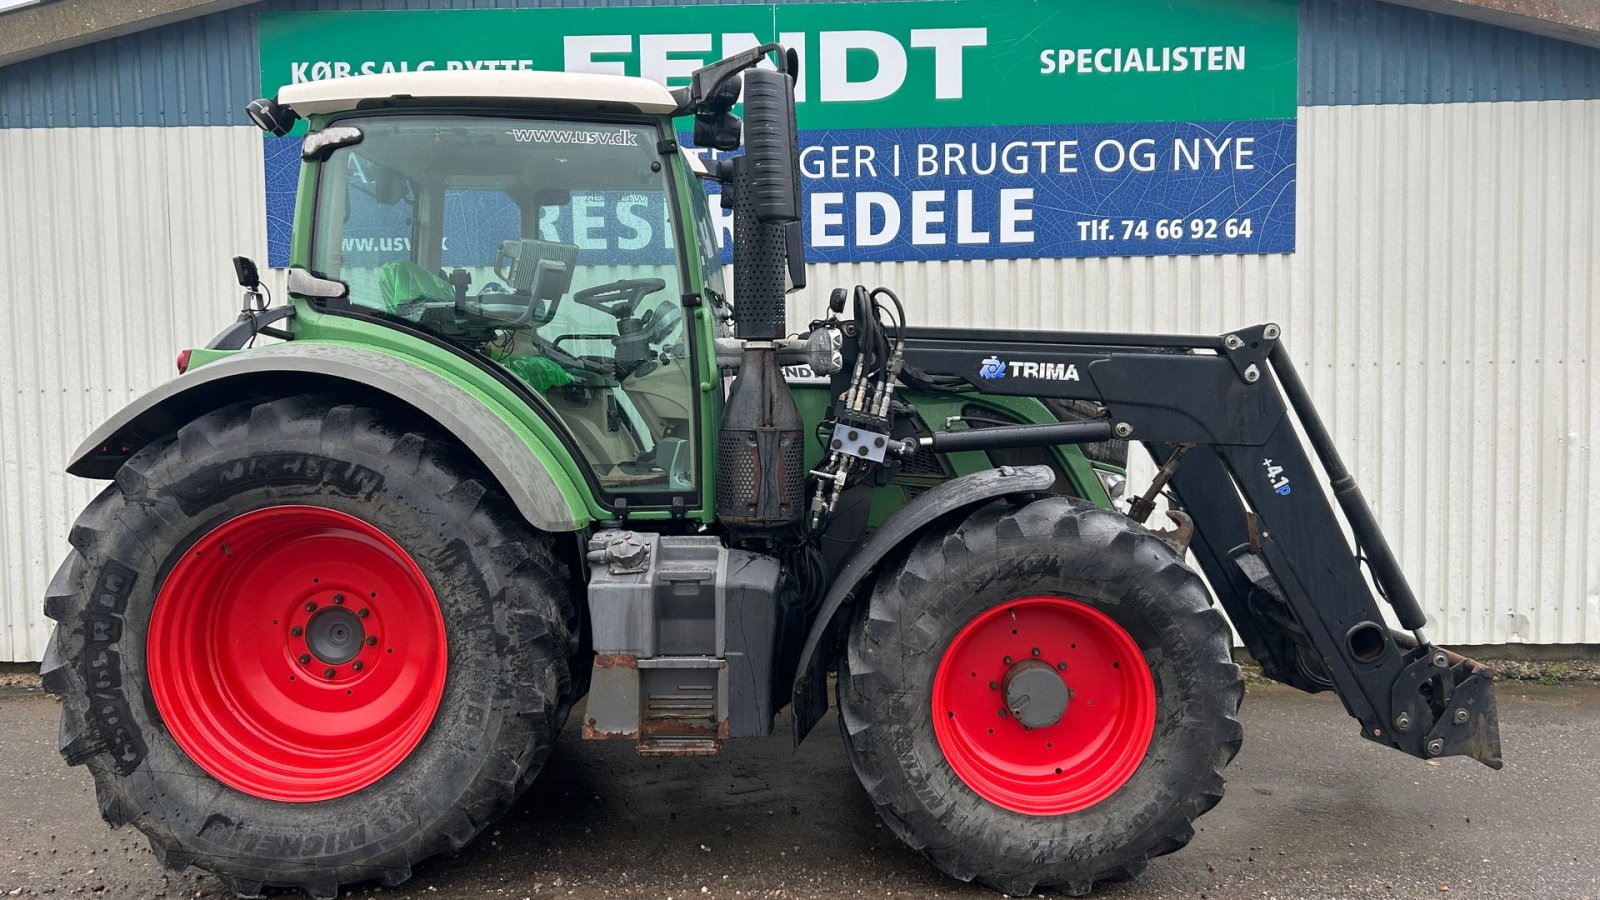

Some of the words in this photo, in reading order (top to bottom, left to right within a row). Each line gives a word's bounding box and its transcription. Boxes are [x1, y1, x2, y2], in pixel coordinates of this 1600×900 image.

[1040, 46, 1246, 74] SPECIALISTEN
[512, 129, 638, 147] www.usv.dk
[893, 144, 900, 177] I
[917, 140, 1078, 176] BRUGTE
[1094, 138, 1156, 172] OG
[1174, 137, 1255, 171] NYE
[1077, 219, 1114, 241] Tlf.
[1121, 219, 1149, 240] 74
[1155, 219, 1183, 239] 66
[1190, 218, 1218, 239] 92
[1225, 218, 1253, 239] 64
[1009, 361, 1080, 382] TRIMA
